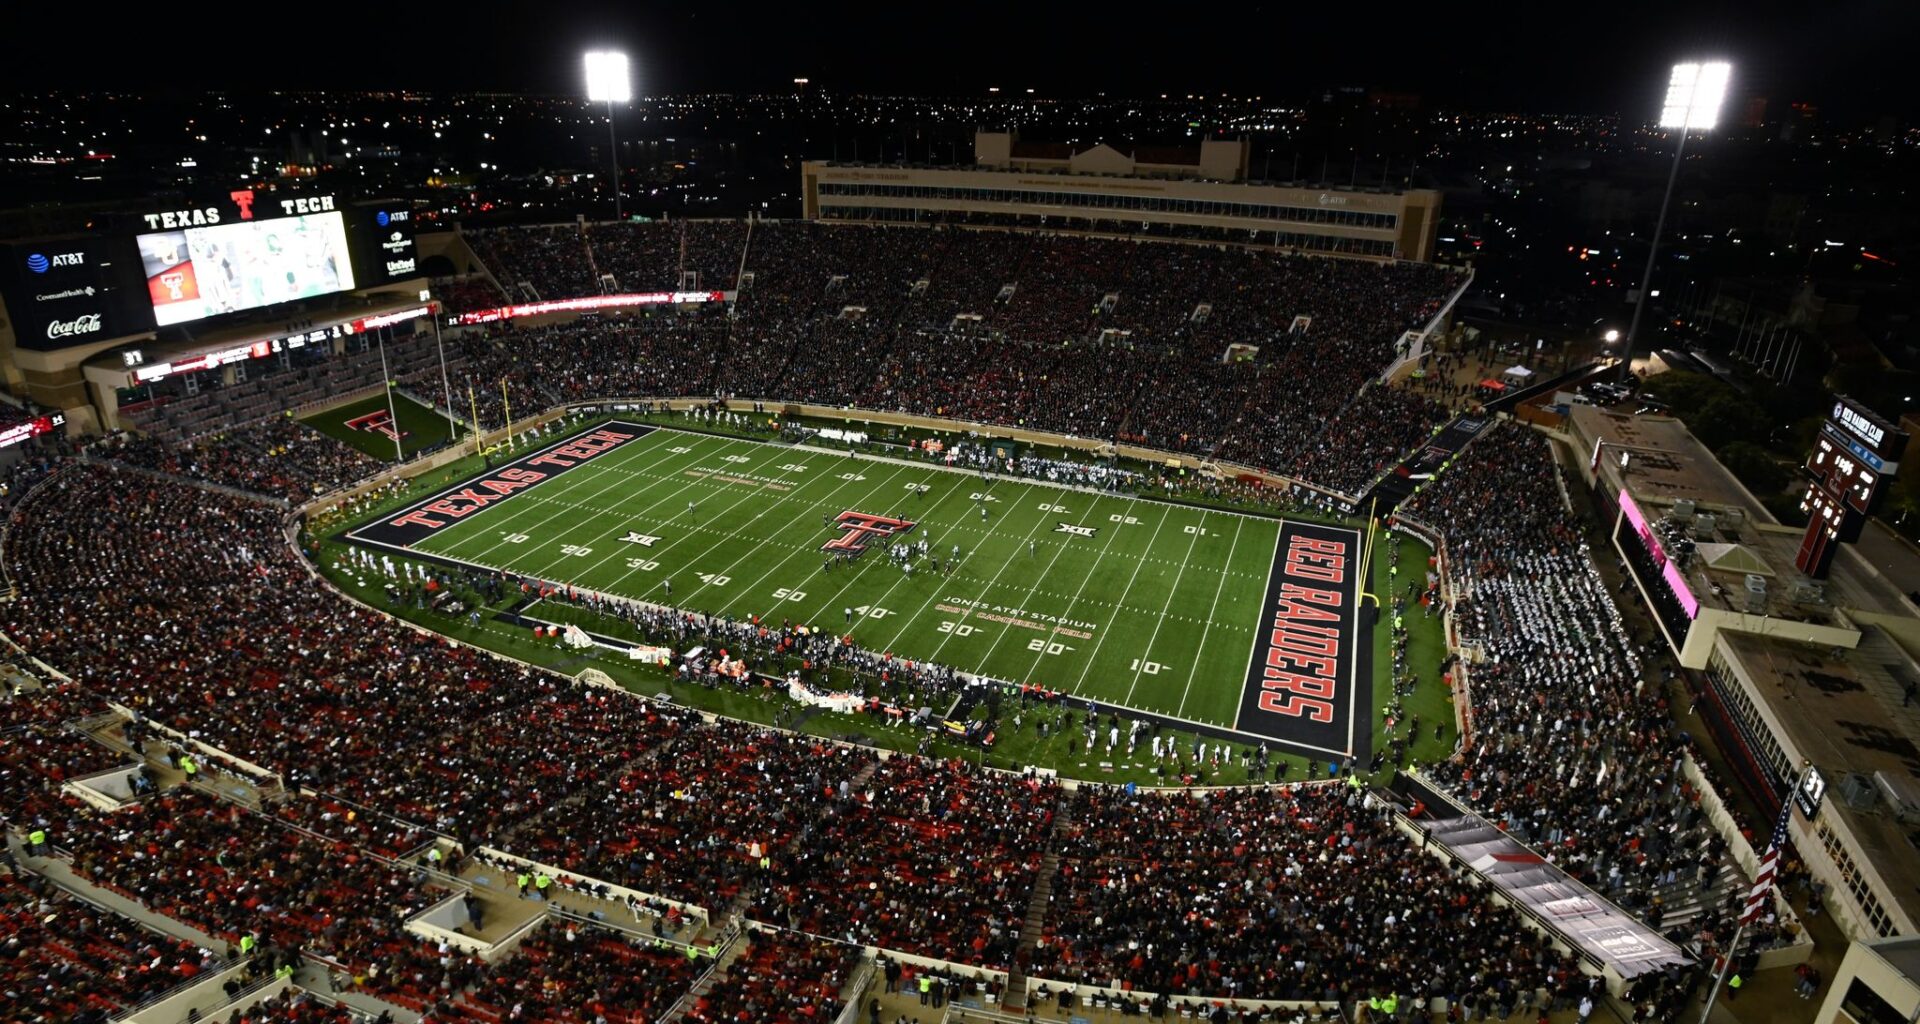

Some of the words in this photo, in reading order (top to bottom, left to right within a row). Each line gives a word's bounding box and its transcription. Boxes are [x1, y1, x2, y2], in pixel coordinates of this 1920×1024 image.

[144, 208, 220, 229] TEXAS
[281, 196, 334, 215] TECH
[390, 211, 409, 222] AT&T
[52, 252, 84, 267] AT&T
[386, 257, 415, 271] United
[390, 468, 547, 528] TEXAS
[527, 430, 634, 467] TECH
[752, 475, 798, 486] STADIUM
[1183, 525, 1207, 536] 10
[503, 533, 530, 543] 10
[560, 545, 593, 557] 20
[626, 558, 660, 571] 30
[1284, 534, 1345, 583] RED
[699, 573, 731, 586] 40
[772, 588, 807, 601] 50
[853, 605, 889, 619] 40
[943, 596, 989, 609] JONES
[992, 606, 1028, 617] AT&T
[1030, 612, 1097, 630] STADIUM
[935, 604, 972, 616] CODY
[976, 612, 1047, 631] CAMPBELL
[1052, 626, 1093, 640] FIELD
[937, 621, 974, 637] 30
[1027, 638, 1065, 656] 20
[1258, 582, 1342, 723] RAIDERS
[1130, 658, 1162, 675] 10
